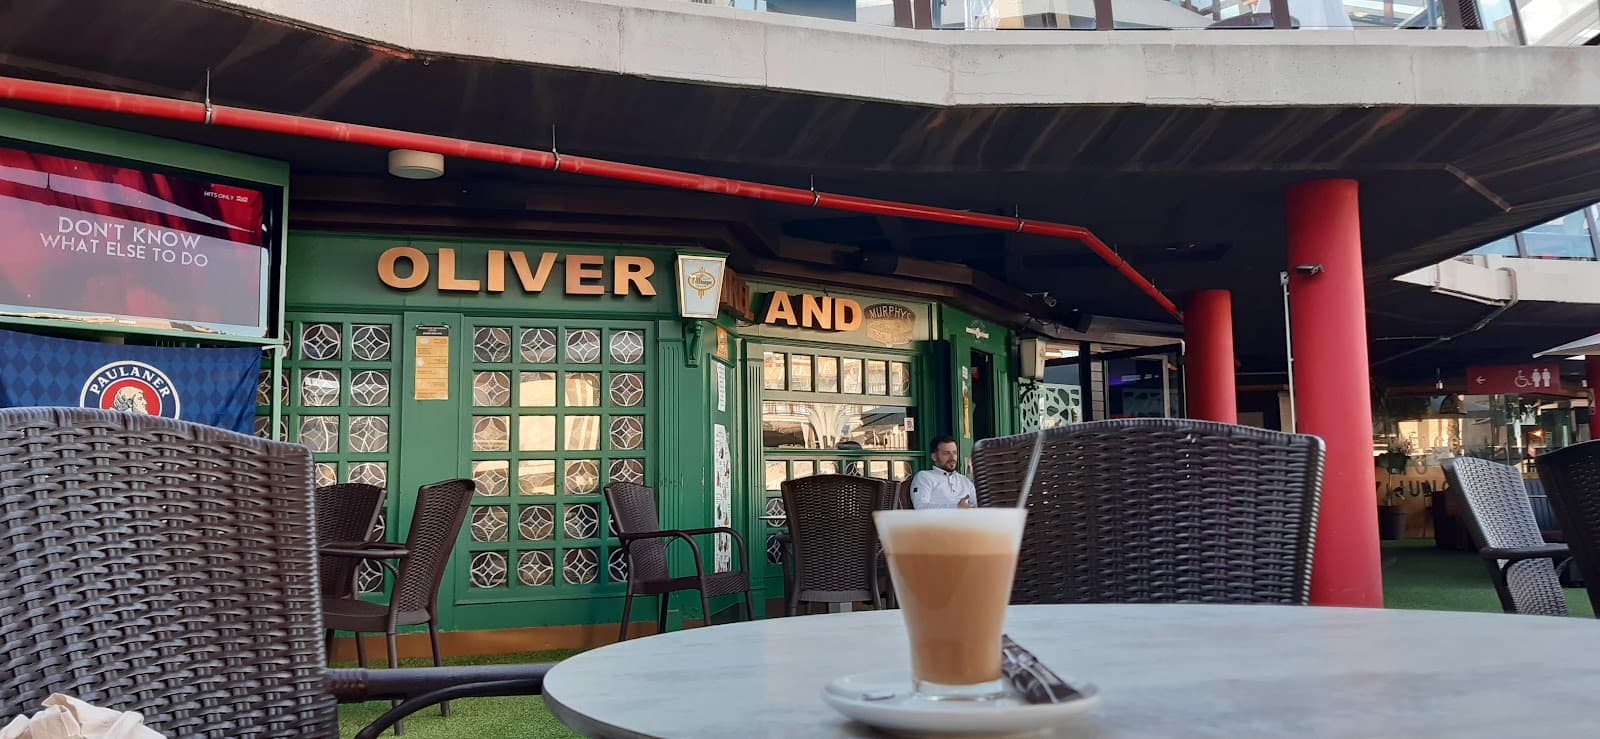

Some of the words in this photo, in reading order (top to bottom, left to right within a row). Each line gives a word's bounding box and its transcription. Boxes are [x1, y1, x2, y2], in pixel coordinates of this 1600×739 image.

[203, 190, 218, 199] HITS
[218, 193, 234, 201] ONLY
[58, 216, 125, 241] DON'T
[133, 226, 201, 249] KNOW
[39, 232, 99, 254] WHAT
[106, 241, 146, 260] ELSE
[152, 247, 176, 263] TO
[181, 251, 209, 268] DO
[377, 246, 657, 296] OLIVER
[764, 290, 863, 331] AND
[89, 366, 171, 398] PAULANER
